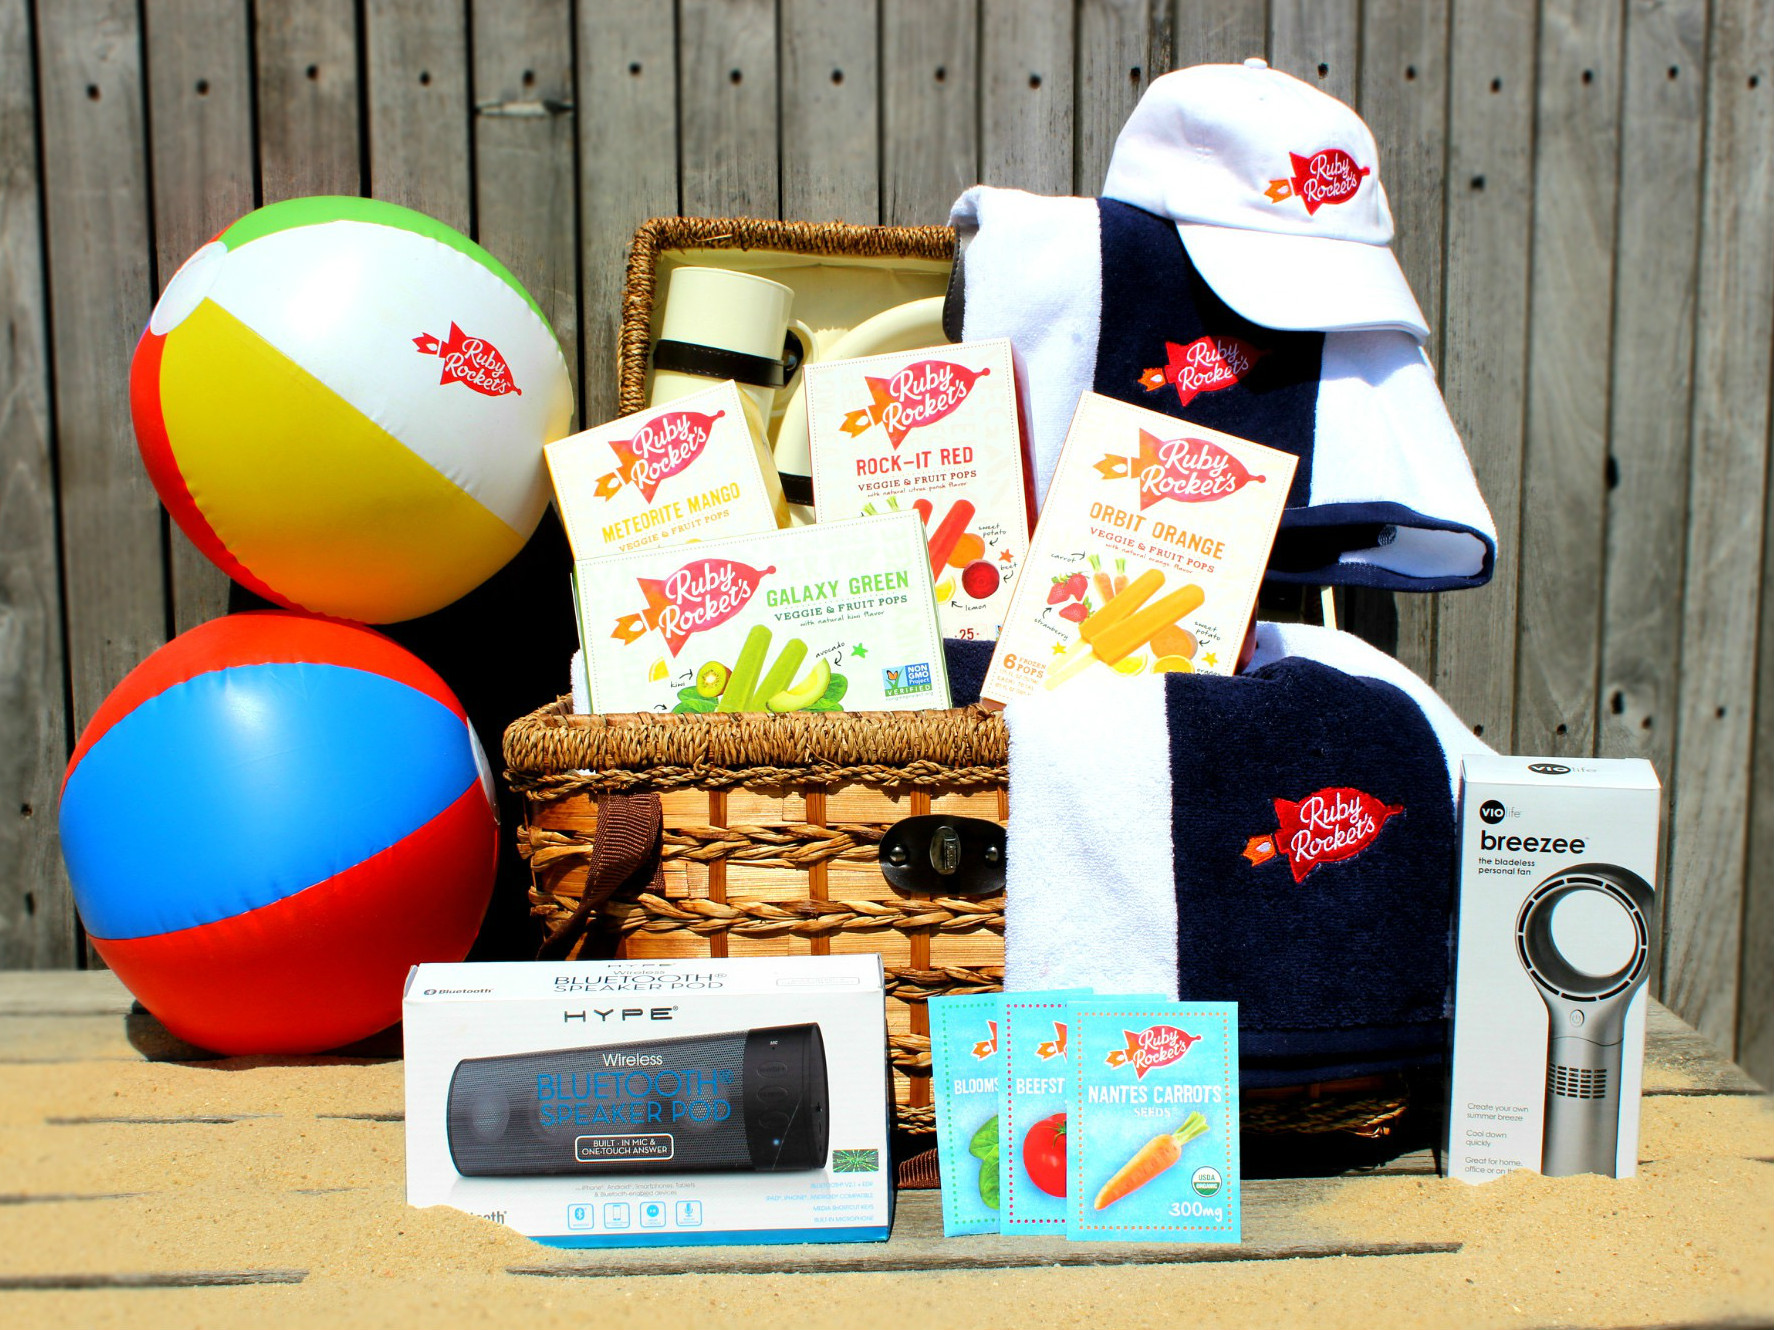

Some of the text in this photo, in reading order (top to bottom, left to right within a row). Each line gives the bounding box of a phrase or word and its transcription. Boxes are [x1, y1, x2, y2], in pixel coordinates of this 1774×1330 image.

[1310, 153, 1350, 180] Ruby
[1303, 172, 1357, 202] Rocket's
[462, 339, 505, 377] Ruby
[1187, 340, 1239, 367] Ruby
[445, 352, 508, 393] Rocket's
[890, 364, 953, 402] Ruby
[1178, 355, 1249, 391] Rocket's
[882, 379, 967, 433] Rocket's
[632, 414, 690, 458] Ruby
[631, 426, 706, 489] Rocket's
[856, 446, 973, 476] ROCK-IT RED
[1159, 440, 1229, 477] Ruby
[858, 479, 901, 491] VEGGIE
[914, 474, 947, 485] FRUIT
[950, 470, 977, 480] POPS
[1141, 464, 1235, 495] Rocket's
[883, 488, 906, 496] natural
[602, 482, 741, 544] METEORITE MANGO
[619, 534, 659, 552] VEGGIE
[671, 520, 701, 535] FRUIT
[704, 509, 730, 523] POPS
[983, 529, 1007, 538] potato
[1089, 502, 1226, 560] ORBIT ORANGE
[1051, 553, 1077, 563] carrot
[1090, 527, 1215, 573] VEGGIE & FRUIT POPS
[1000, 562, 1018, 570] beet
[1122, 548, 1147, 559] natural
[1149, 557, 1170, 567] orange
[1174, 564, 1193, 574] flavor
[665, 563, 735, 604] Ruby
[766, 570, 909, 607] GALAXY GREEN
[659, 579, 751, 638] Rocket's
[774, 607, 823, 621] VEGGIE
[838, 599, 875, 612] FRUIT
[879, 595, 908, 606] POPS
[800, 618, 815, 627] with
[818, 615, 844, 624] natural
[864, 610, 885, 618] flavor
[960, 628, 974, 640] 25
[1034, 618, 1068, 641] strawberry
[1195, 621, 1217, 632] sweet
[1196, 629, 1221, 641] potato
[815, 641, 846, 658] avocado
[907, 664, 928, 672] NON
[1003, 653, 1047, 669] 6 FROZEN
[1016, 663, 1044, 678] POPS
[908, 671, 929, 680] GMO
[887, 685, 931, 696] VERIFIED
[1300, 792, 1362, 830] Ruby
[1291, 813, 1376, 862] Rocket's
[1478, 857, 1535, 867] the bladeless
[1478, 867, 1515, 875] personal
[554, 983, 662, 992] SPEAKER
[1138, 1027, 1179, 1050] Ruby
[602, 1053, 663, 1067] Wireless
[1133, 1040, 1187, 1068] Rocket's
[1088, 1084, 1222, 1104] NANTES CARROTS
[540, 1099, 731, 1126] SPEAKER POD
[1134, 1107, 1171, 1118] SEEDS
[1467, 1102, 1494, 1110] Create
[1495, 1105, 1511, 1113] your
[1467, 1112, 1524, 1121] summer breeze
[632, 1138, 648, 1146] MIC
[1465, 1129, 1484, 1138] Cool
[632, 1146, 668, 1154] ANSWER
[1465, 1156, 1487, 1165] Great
[1487, 1157, 1498, 1165] for
[1198, 1173, 1216, 1181] USDA
[1464, 1165, 1486, 1174] office
[1168, 1201, 1223, 1222] 300mg
